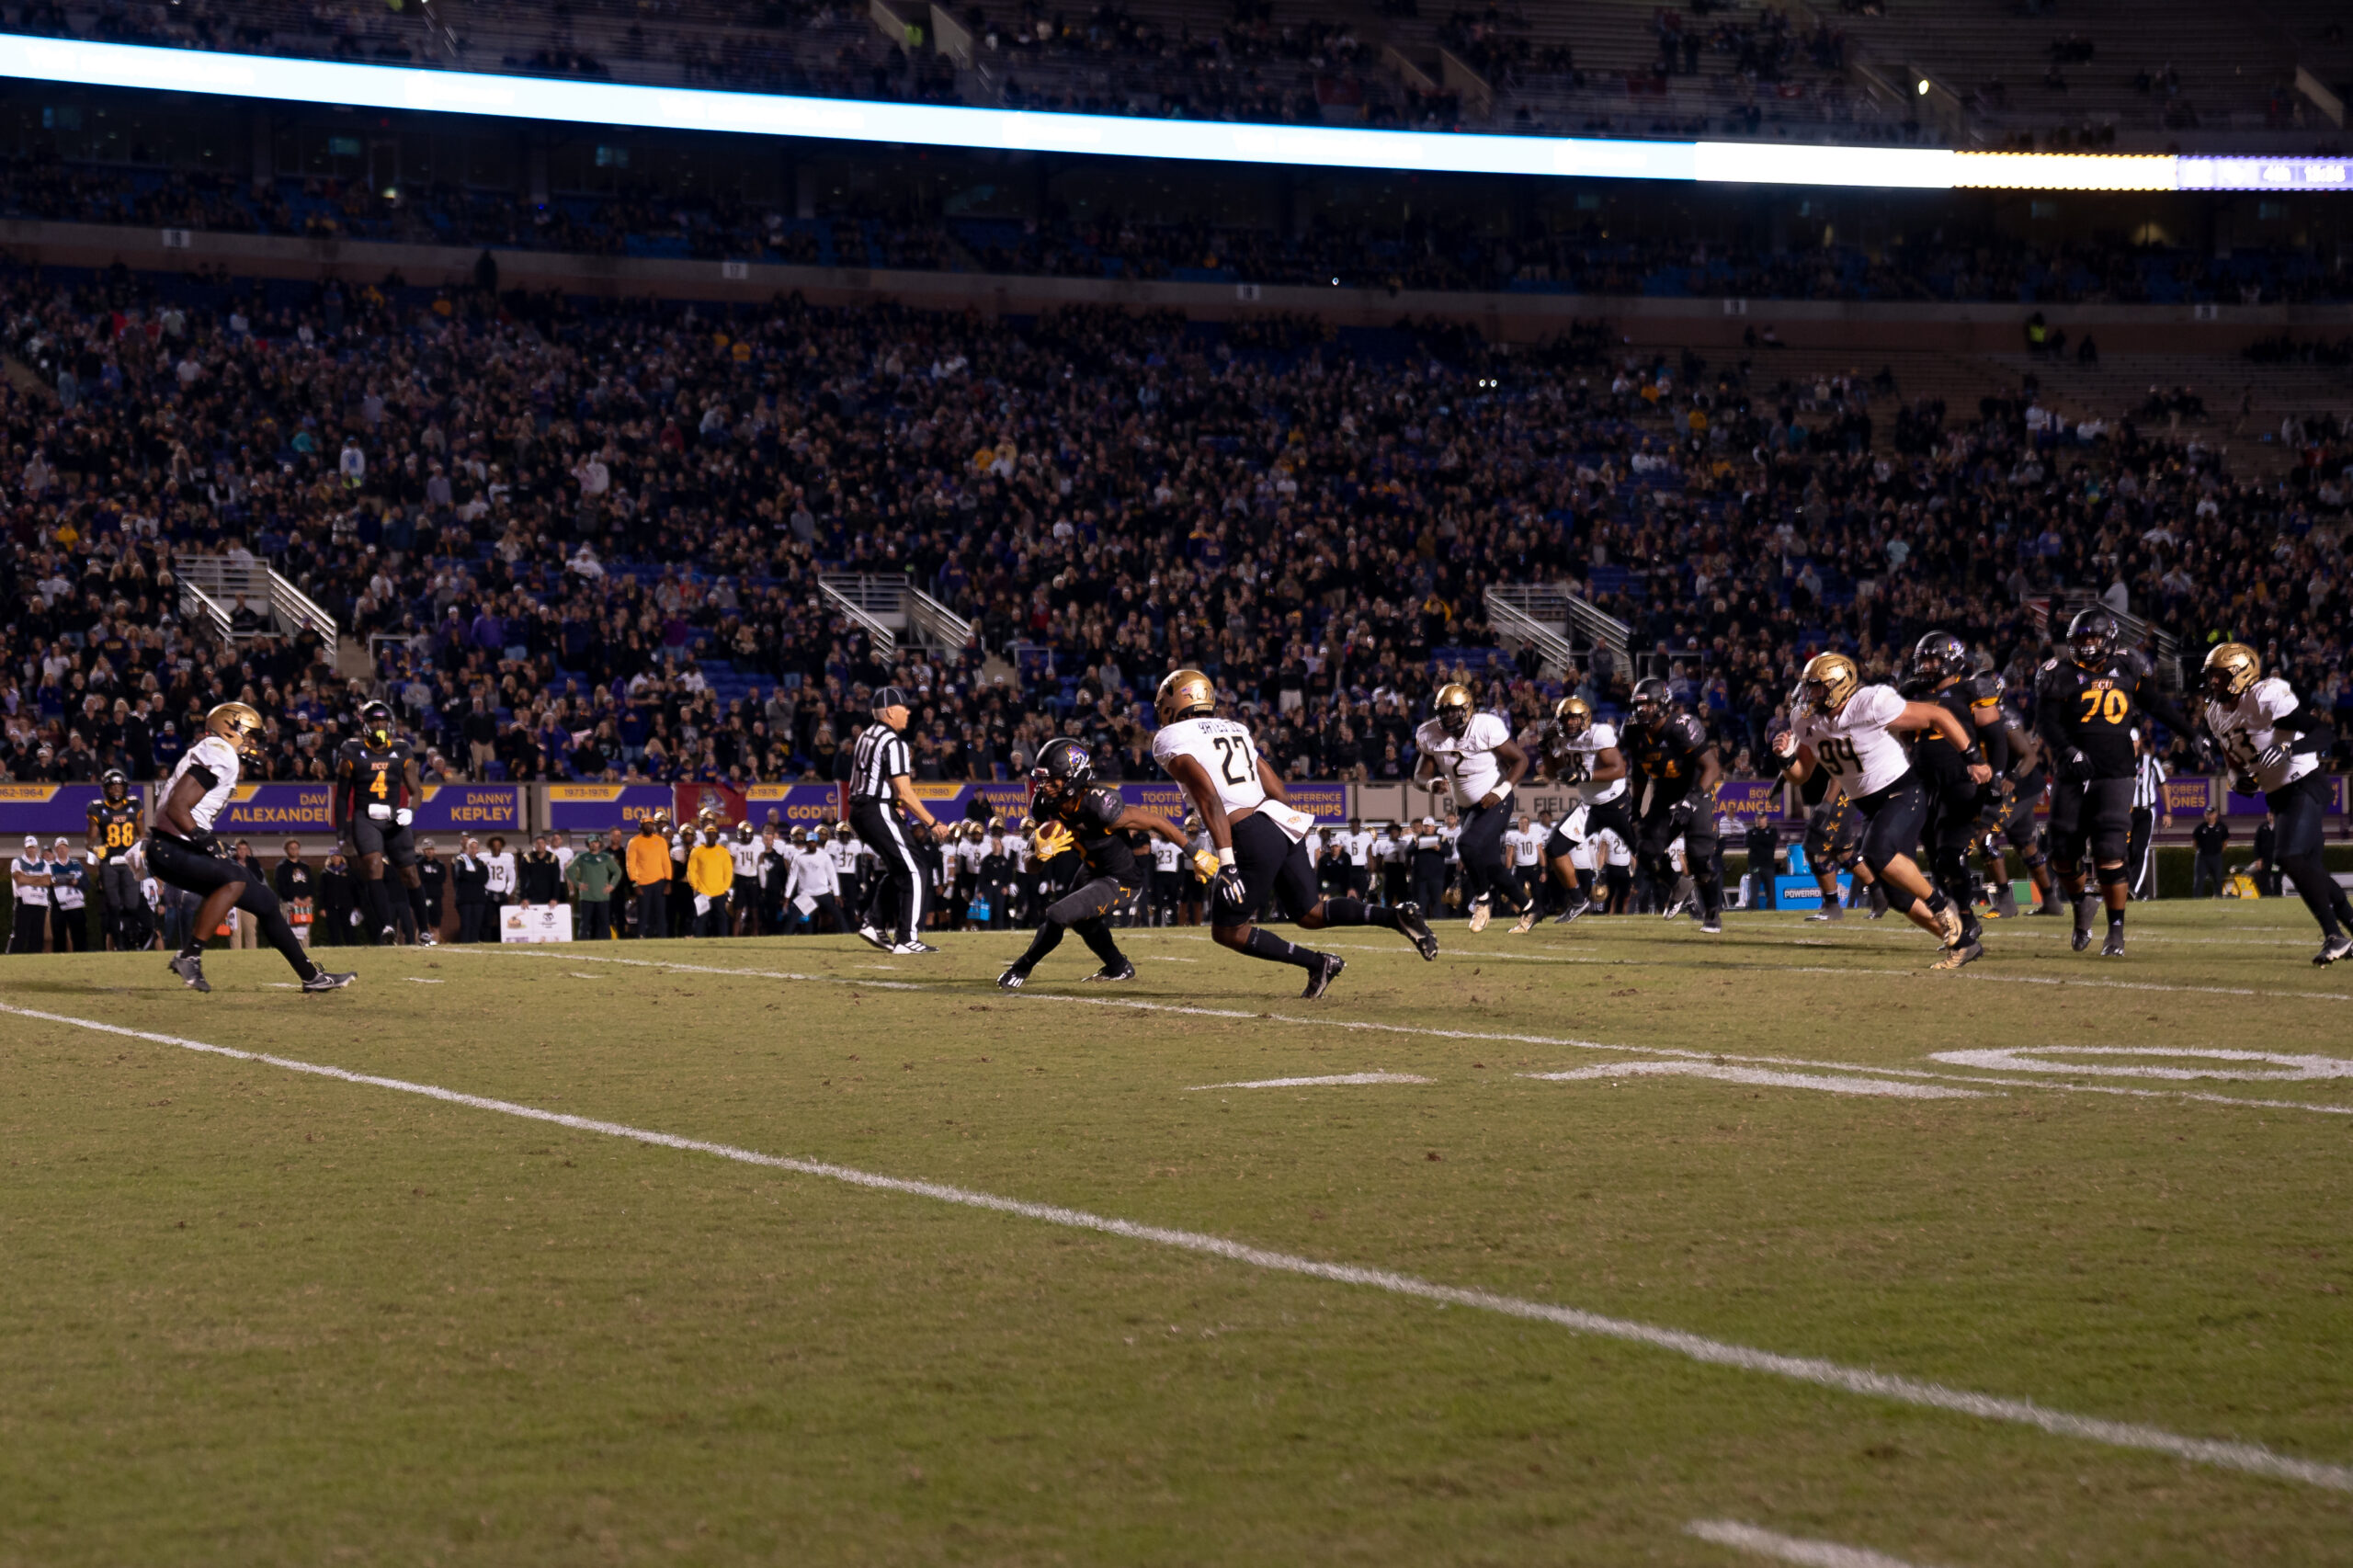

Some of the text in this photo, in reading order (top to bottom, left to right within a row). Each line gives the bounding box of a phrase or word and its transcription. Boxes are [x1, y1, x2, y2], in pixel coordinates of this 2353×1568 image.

[2080, 688, 2129, 725] 70
[1212, 735, 1256, 787] 27
[1818, 736, 1864, 776] 94
[369, 770, 389, 800] 4
[300, 793, 328, 805] DAV
[466, 792, 514, 804] DANNY
[986, 791, 1028, 803] WAYNE
[1142, 791, 1183, 803] TOOTIE
[1288, 792, 1343, 803] NFERENCE
[1534, 797, 1580, 813] FIELD
[2171, 797, 2207, 809] ONES
[450, 806, 514, 822] KEPLEY
[106, 823, 135, 848] 88
[1350, 841, 1358, 856] 6
[1521, 841, 1533, 856] 10
[740, 851, 755, 867] 14
[839, 851, 855, 869] 37
[1157, 849, 1173, 865] 23
[490, 865, 504, 881] 12
